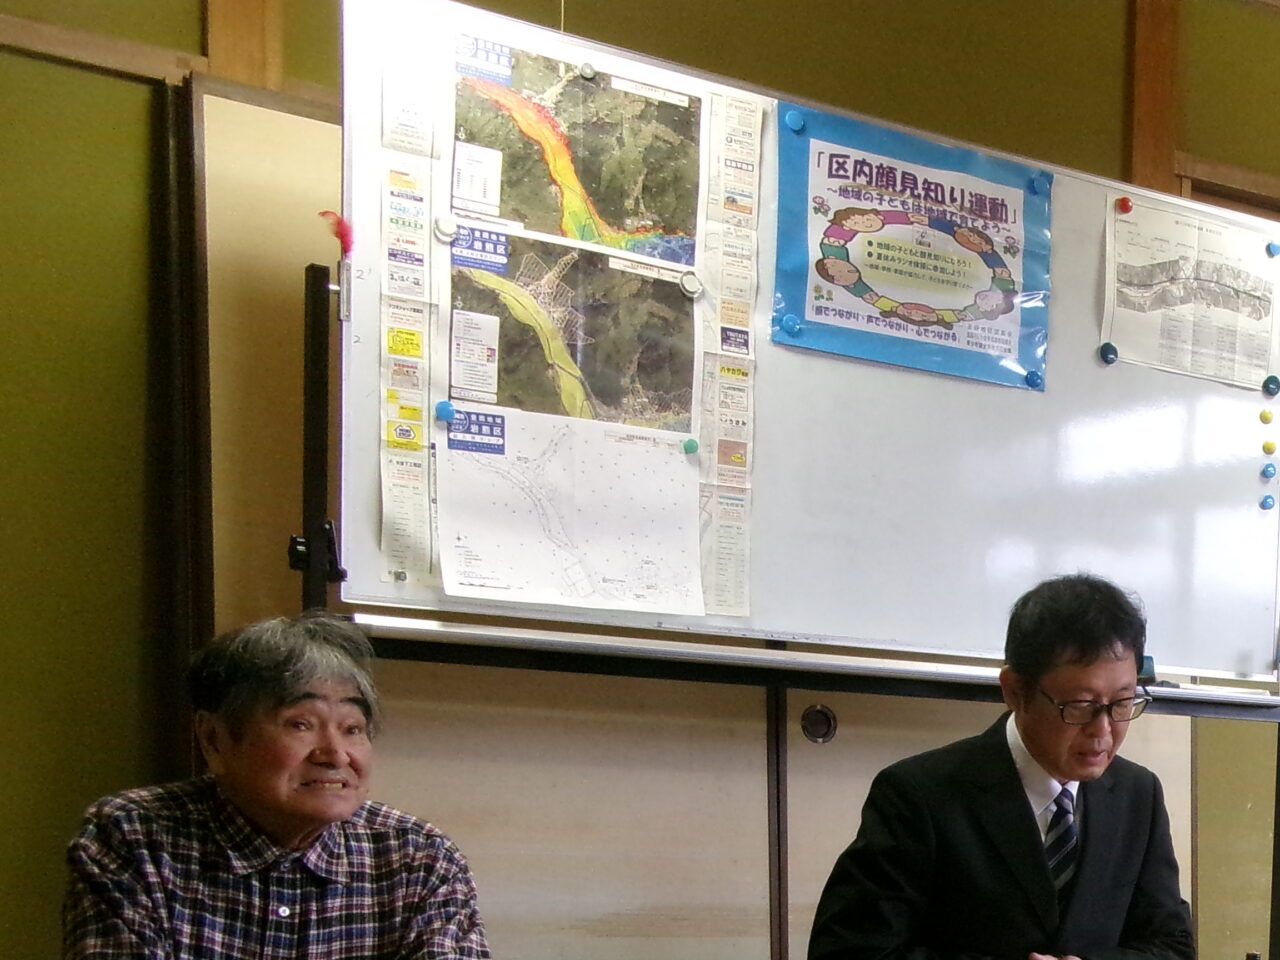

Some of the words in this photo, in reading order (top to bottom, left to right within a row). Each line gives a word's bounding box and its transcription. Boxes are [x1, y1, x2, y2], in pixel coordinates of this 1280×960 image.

[816, 151, 1017, 224] 「区内顔見知り運動」
